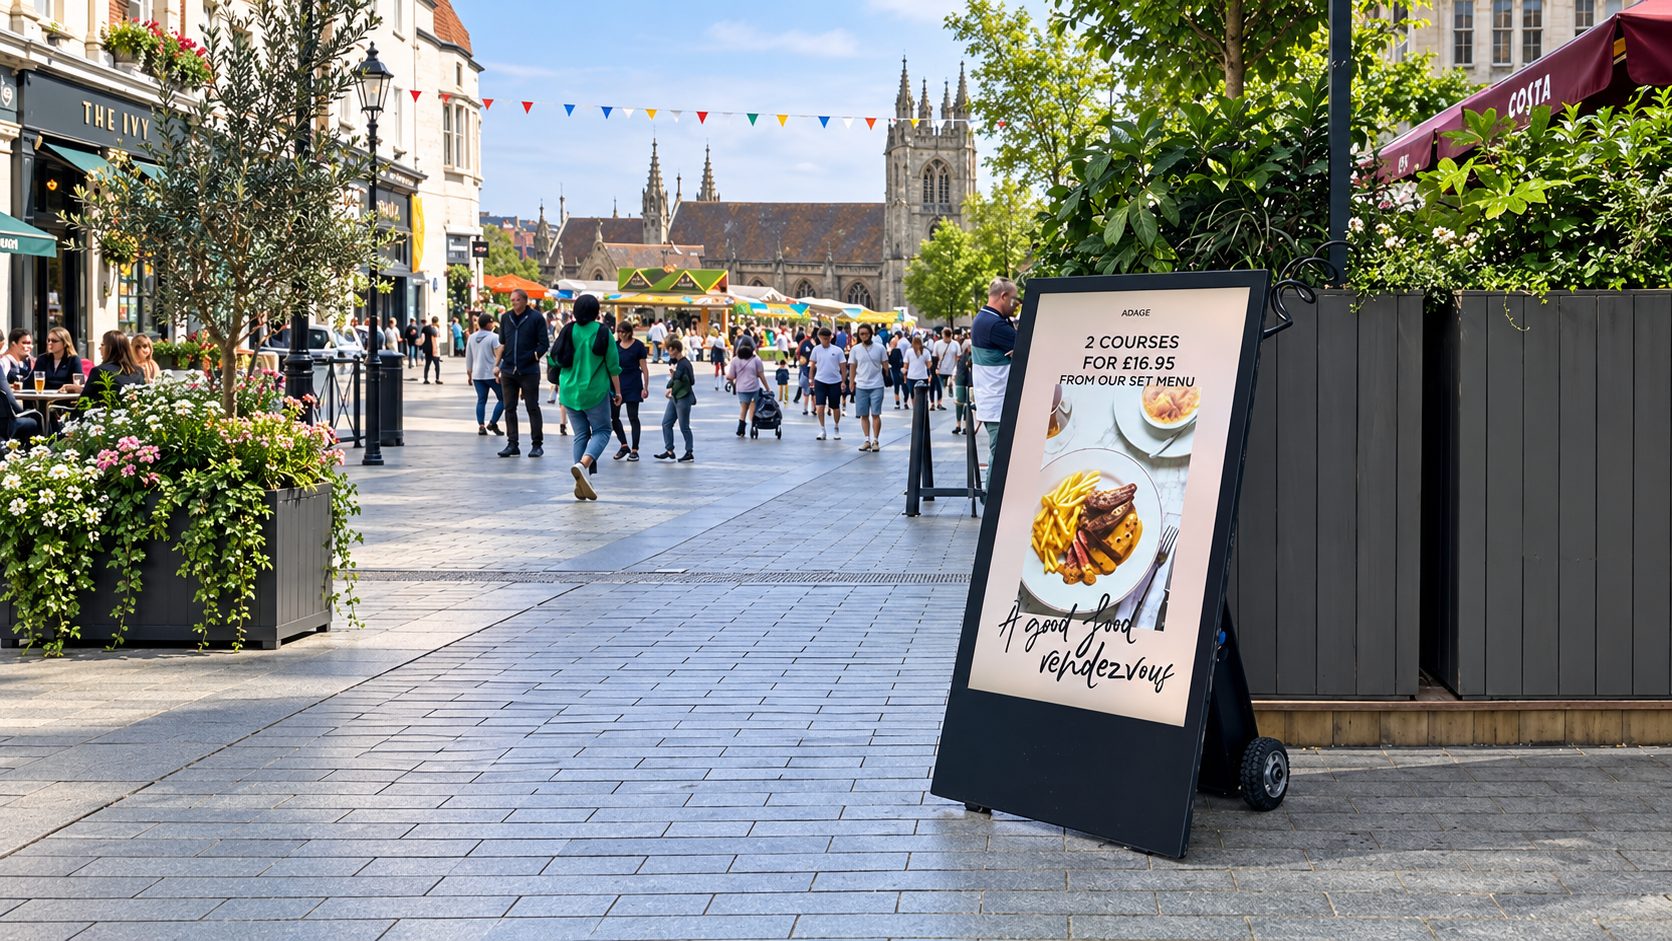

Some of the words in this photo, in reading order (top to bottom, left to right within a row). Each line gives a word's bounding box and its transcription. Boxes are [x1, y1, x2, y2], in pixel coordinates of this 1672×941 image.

[1508, 74, 1551, 119] COSTA
[82, 100, 115, 131] THE
[123, 112, 149, 140] IVY
[1121, 309, 1151, 317] ADAGE
[1084, 335, 1095, 349] 2
[1099, 335, 1180, 349] COURSES
[1082, 356, 1118, 370] FOR
[1122, 356, 1176, 370] £16.95
[1059, 375, 1095, 386] FROM
[1098, 375, 1126, 387] OUR
[1129, 376, 1154, 387] SET
[1156, 376, 1196, 387] MENU
[998, 600, 1022, 653] A
[1025, 603, 1078, 653] good
[1076, 593, 1137, 658] food
[1039, 641, 1175, 694] rendezvous
